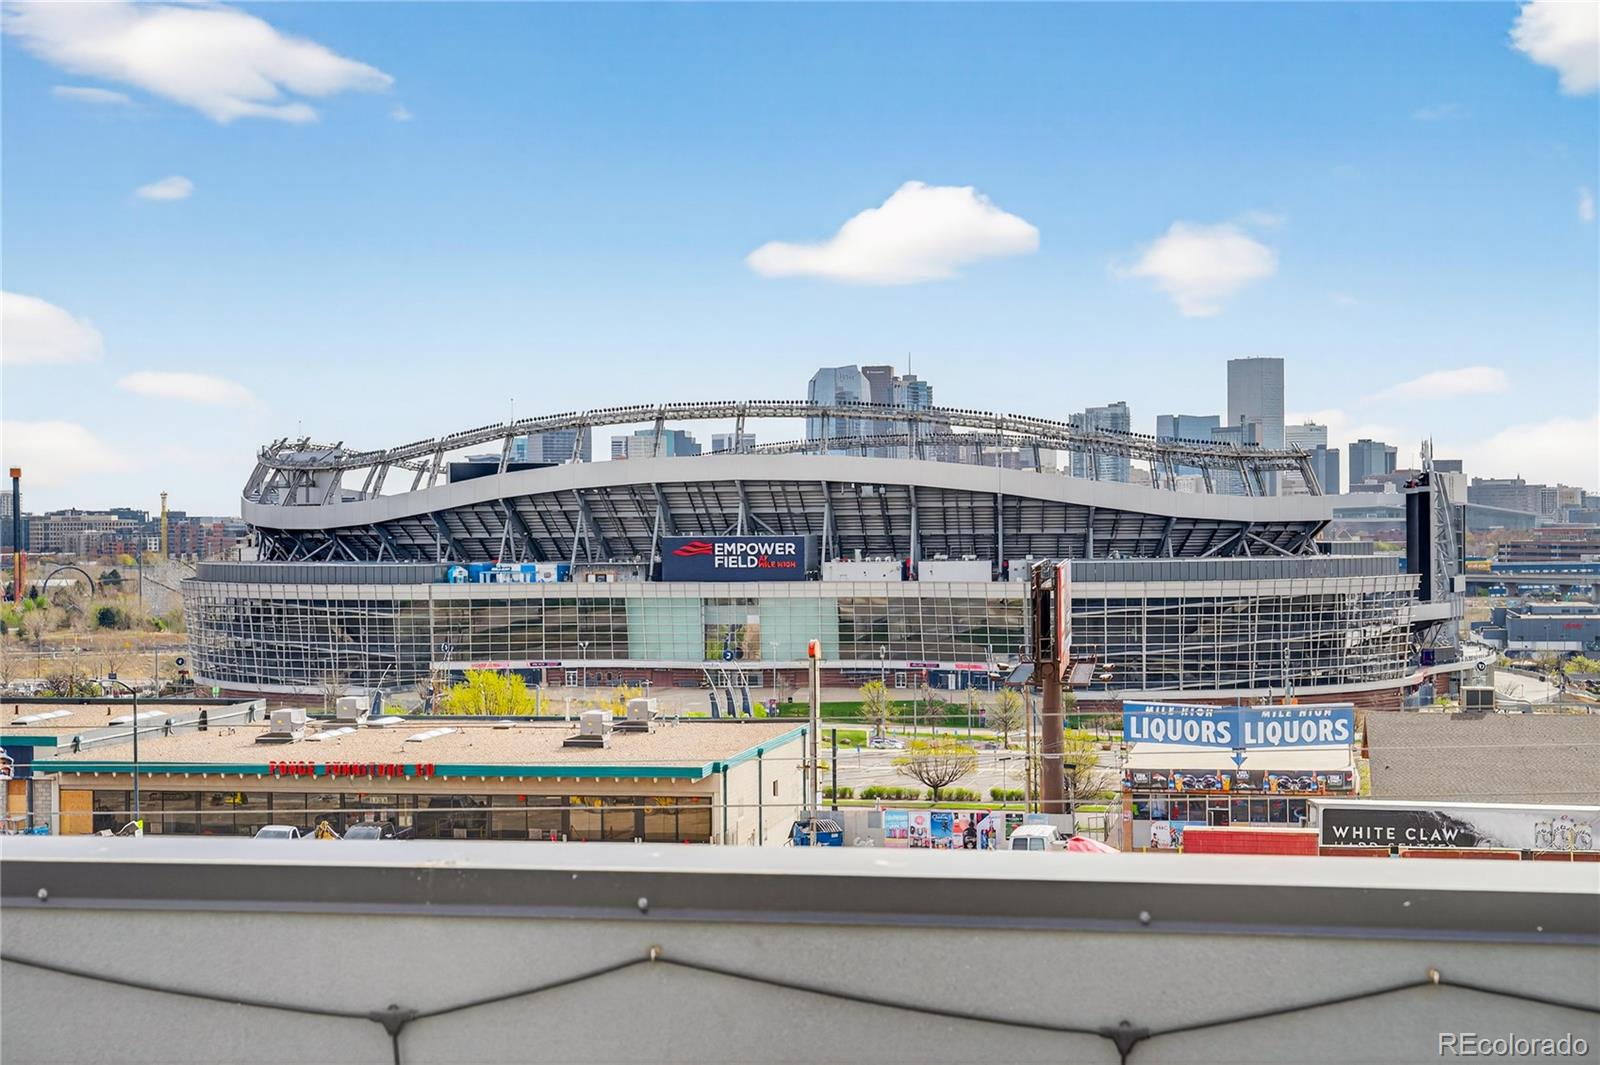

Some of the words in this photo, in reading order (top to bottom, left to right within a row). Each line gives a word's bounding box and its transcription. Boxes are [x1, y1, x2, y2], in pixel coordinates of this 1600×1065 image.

[714, 542, 796, 556] EMPOWER
[714, 556, 758, 569] FIELD
[1130, 716, 1232, 744] LIQUORS
[1245, 718, 1350, 746] LIQUORS
[1332, 825, 1396, 840] WHITE
[1405, 827, 1459, 841] CLAW
